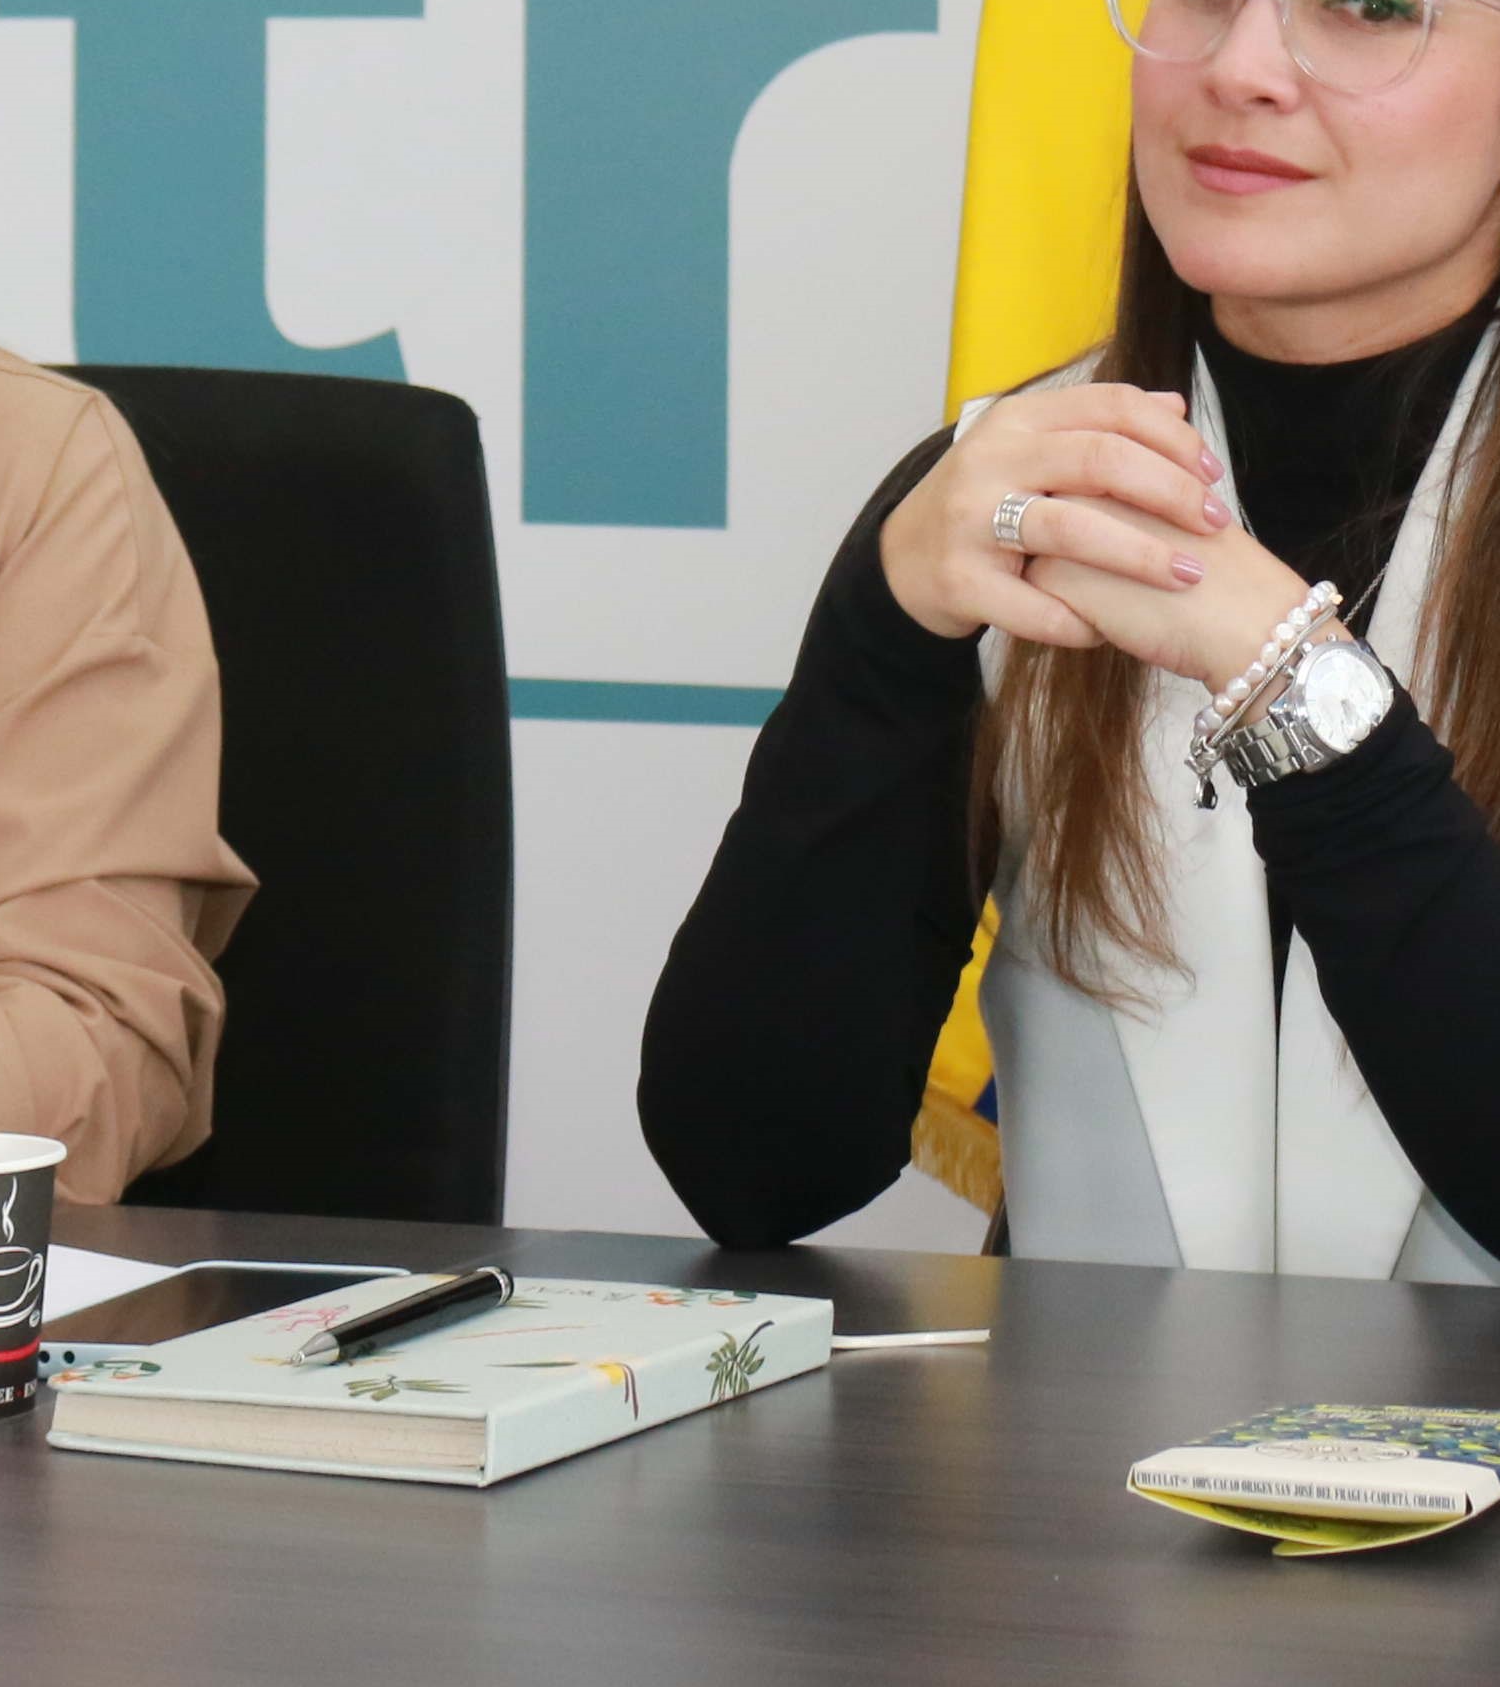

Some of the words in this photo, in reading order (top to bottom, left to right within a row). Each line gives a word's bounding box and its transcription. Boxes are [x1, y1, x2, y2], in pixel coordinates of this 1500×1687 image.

[1192, 1476, 1212, 1490] 100%
[1213, 1478, 1240, 1492] CACAO
[1241, 1479, 1273, 1495] ORIGEN
[1275, 1482, 1291, 1497] SAN
[1294, 1481, 1313, 1498] JOSÉ
[1316, 1485, 1330, 1500] DEL
[1412, 1494, 1456, 1510] COLOMBIA
